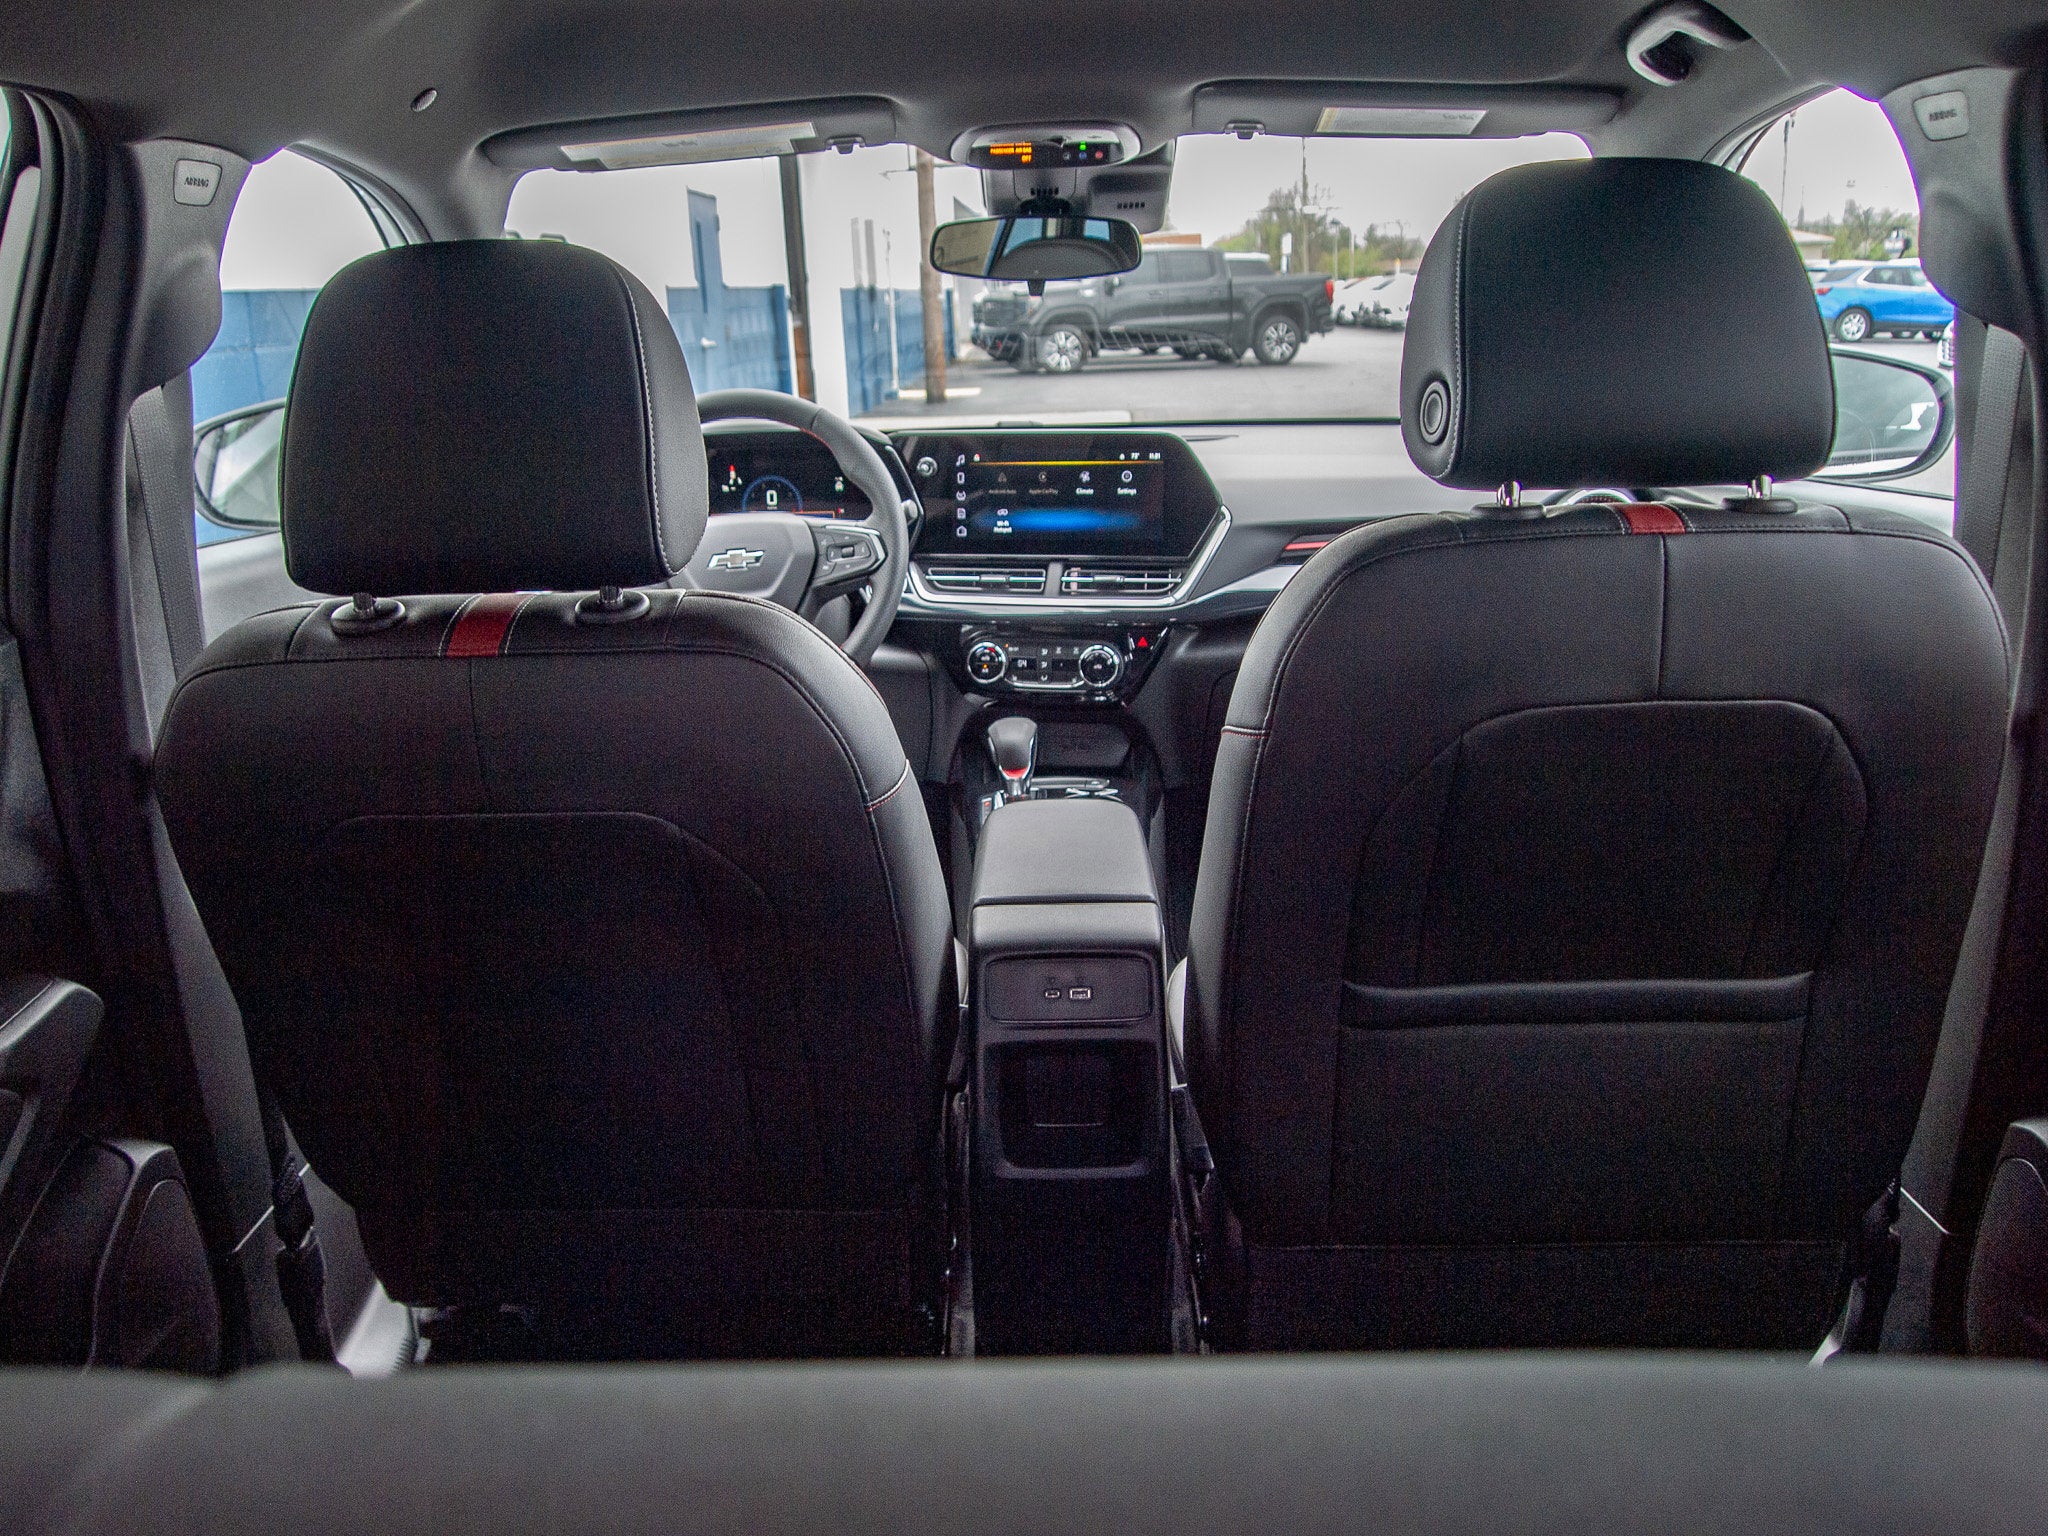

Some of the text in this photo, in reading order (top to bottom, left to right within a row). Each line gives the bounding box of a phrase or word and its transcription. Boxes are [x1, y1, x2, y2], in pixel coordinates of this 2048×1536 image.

[1021, 154, 1032, 163] OFF
[1075, 487, 1094, 495] Climate
[1117, 487, 1137, 496] Settings
[766, 489, 778, 506] 0
